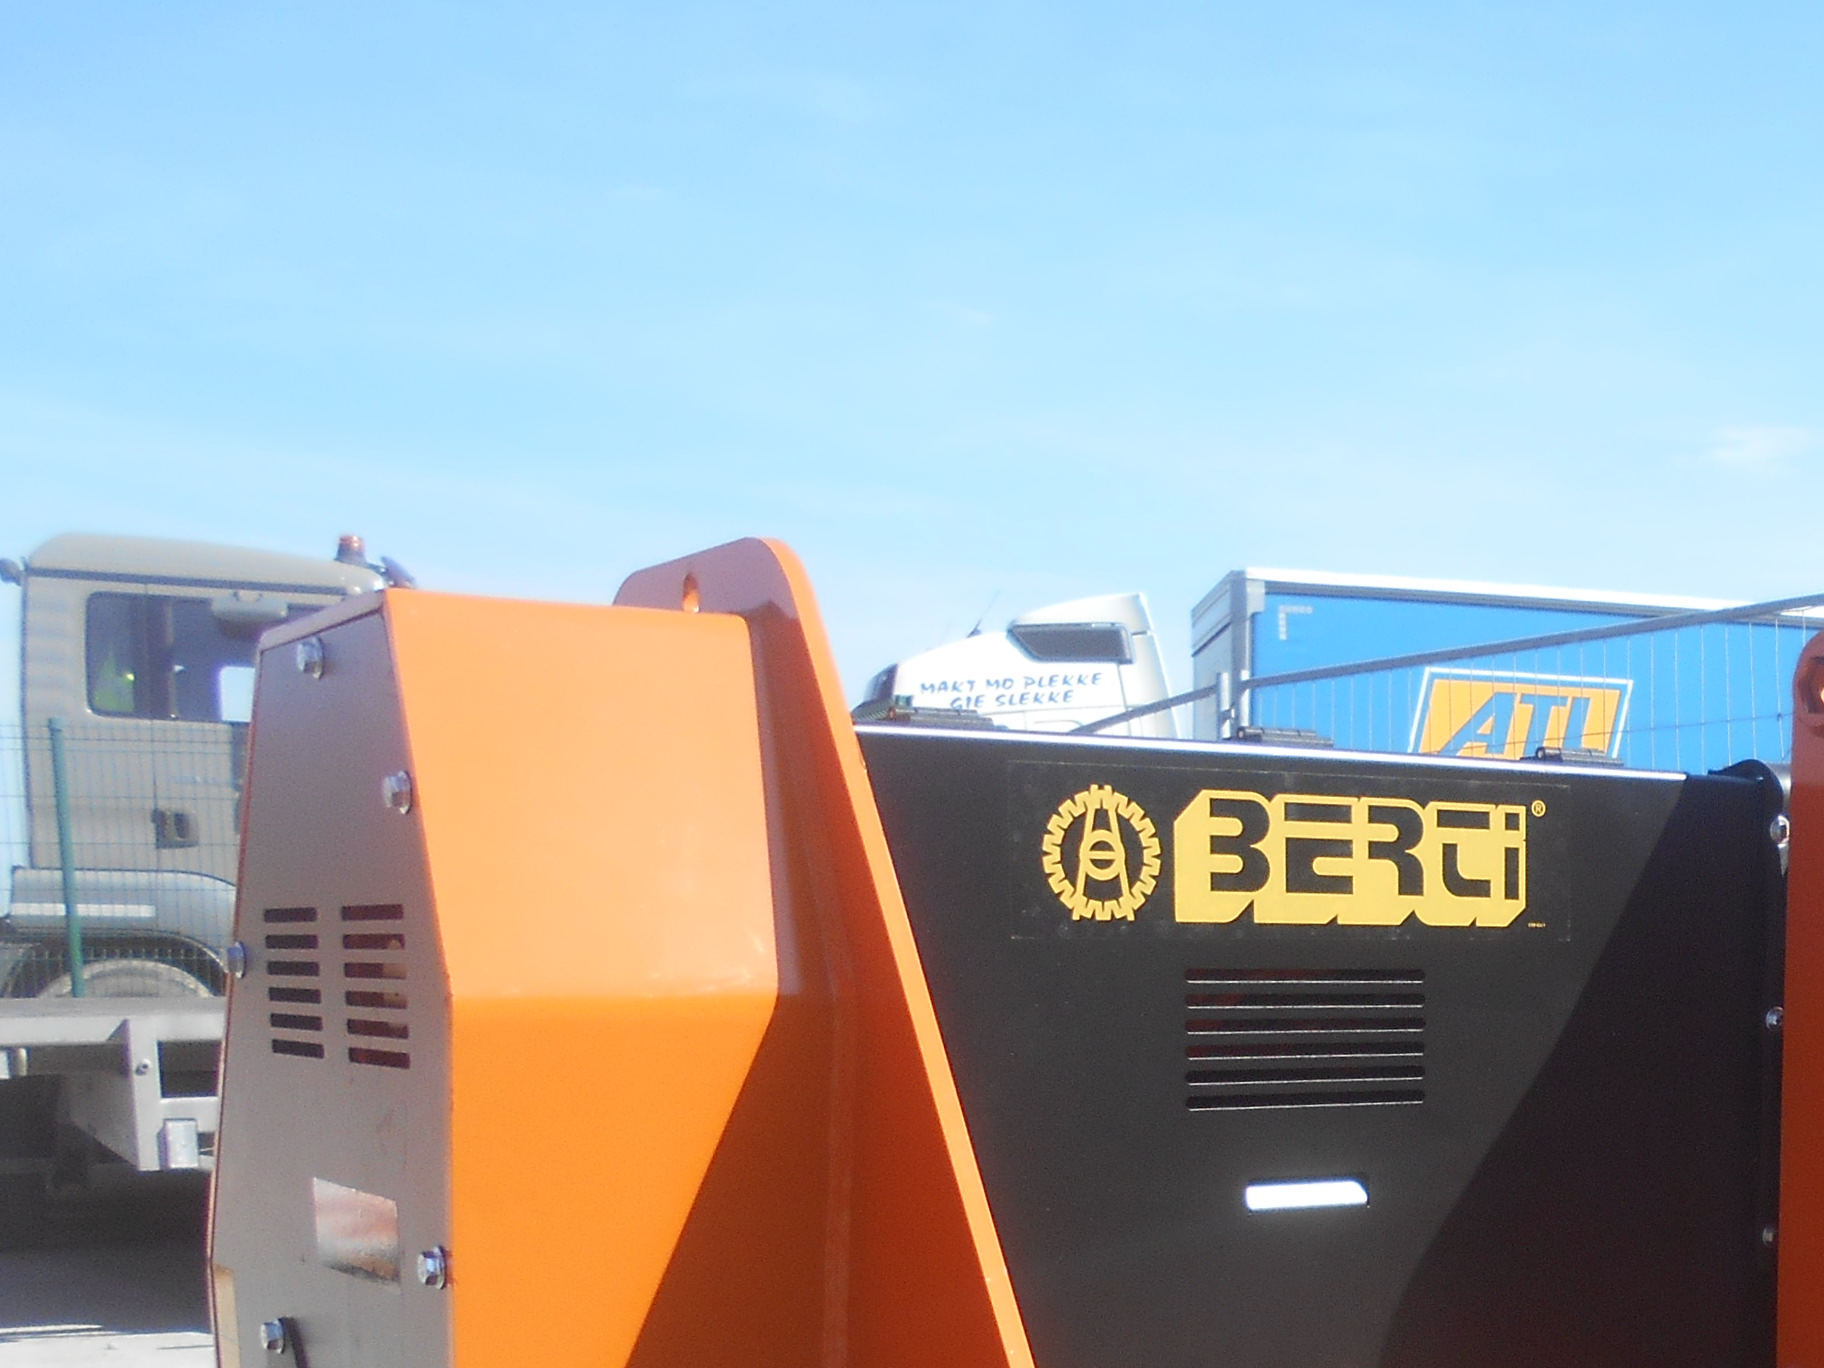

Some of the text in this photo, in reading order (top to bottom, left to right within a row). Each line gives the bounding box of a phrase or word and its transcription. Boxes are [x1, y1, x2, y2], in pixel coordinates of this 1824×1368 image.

[920, 679, 975, 694] MAKT
[1023, 672, 1102, 689] PLEKKE
[996, 690, 1073, 706] SLEKKE
